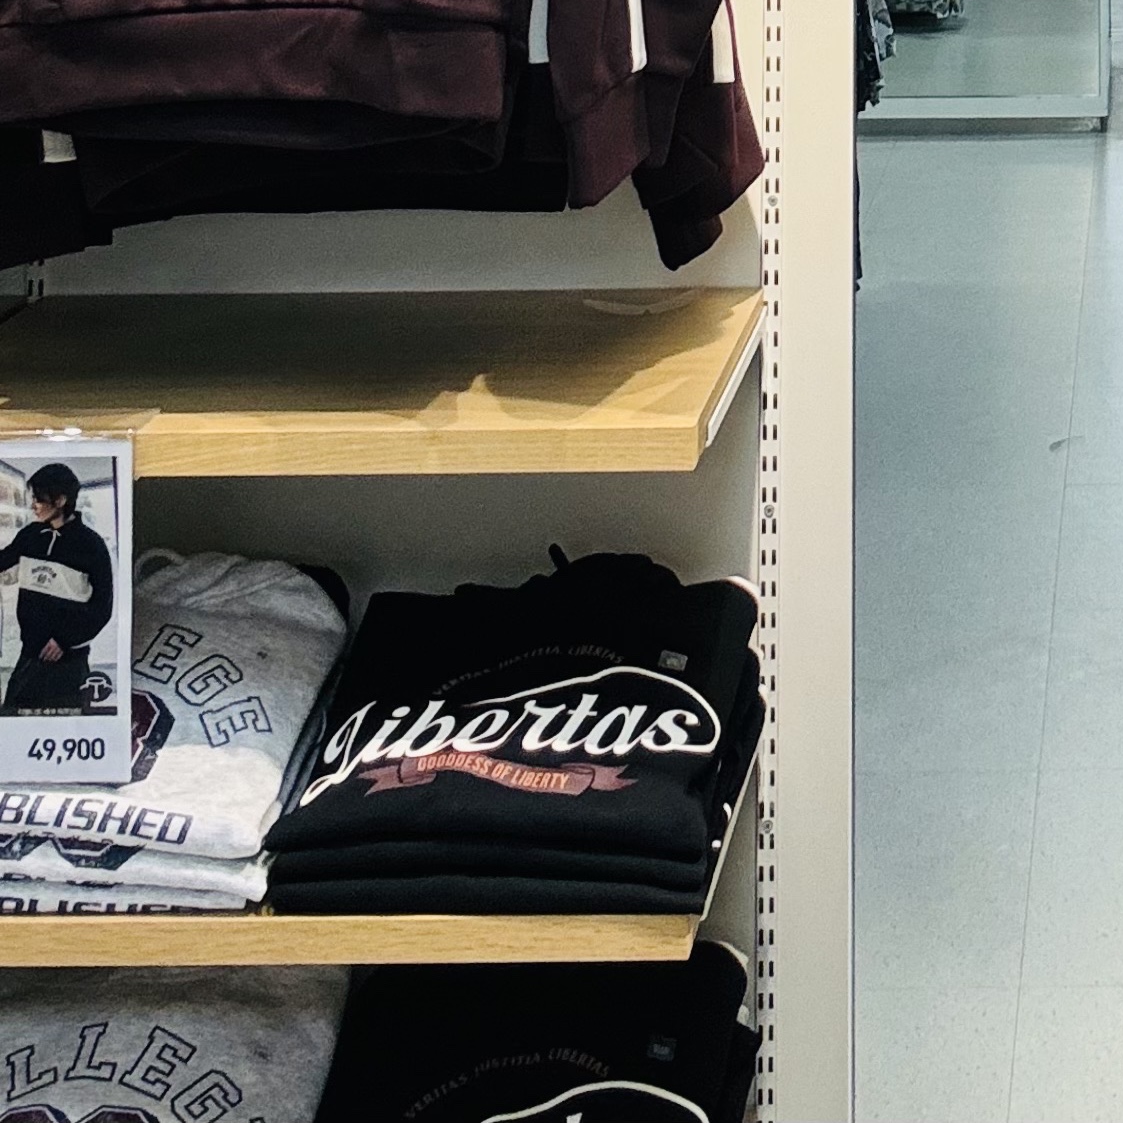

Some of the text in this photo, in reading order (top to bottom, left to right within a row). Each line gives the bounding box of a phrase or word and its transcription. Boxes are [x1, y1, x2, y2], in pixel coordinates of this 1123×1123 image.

[27, 738, 106, 765] 49,900
[300, 666, 721, 807] Libertas
[493, 763, 512, 780] OF
[511, 769, 570, 790] LIBERTY
[6, 1021, 266, 1123] LLEG
